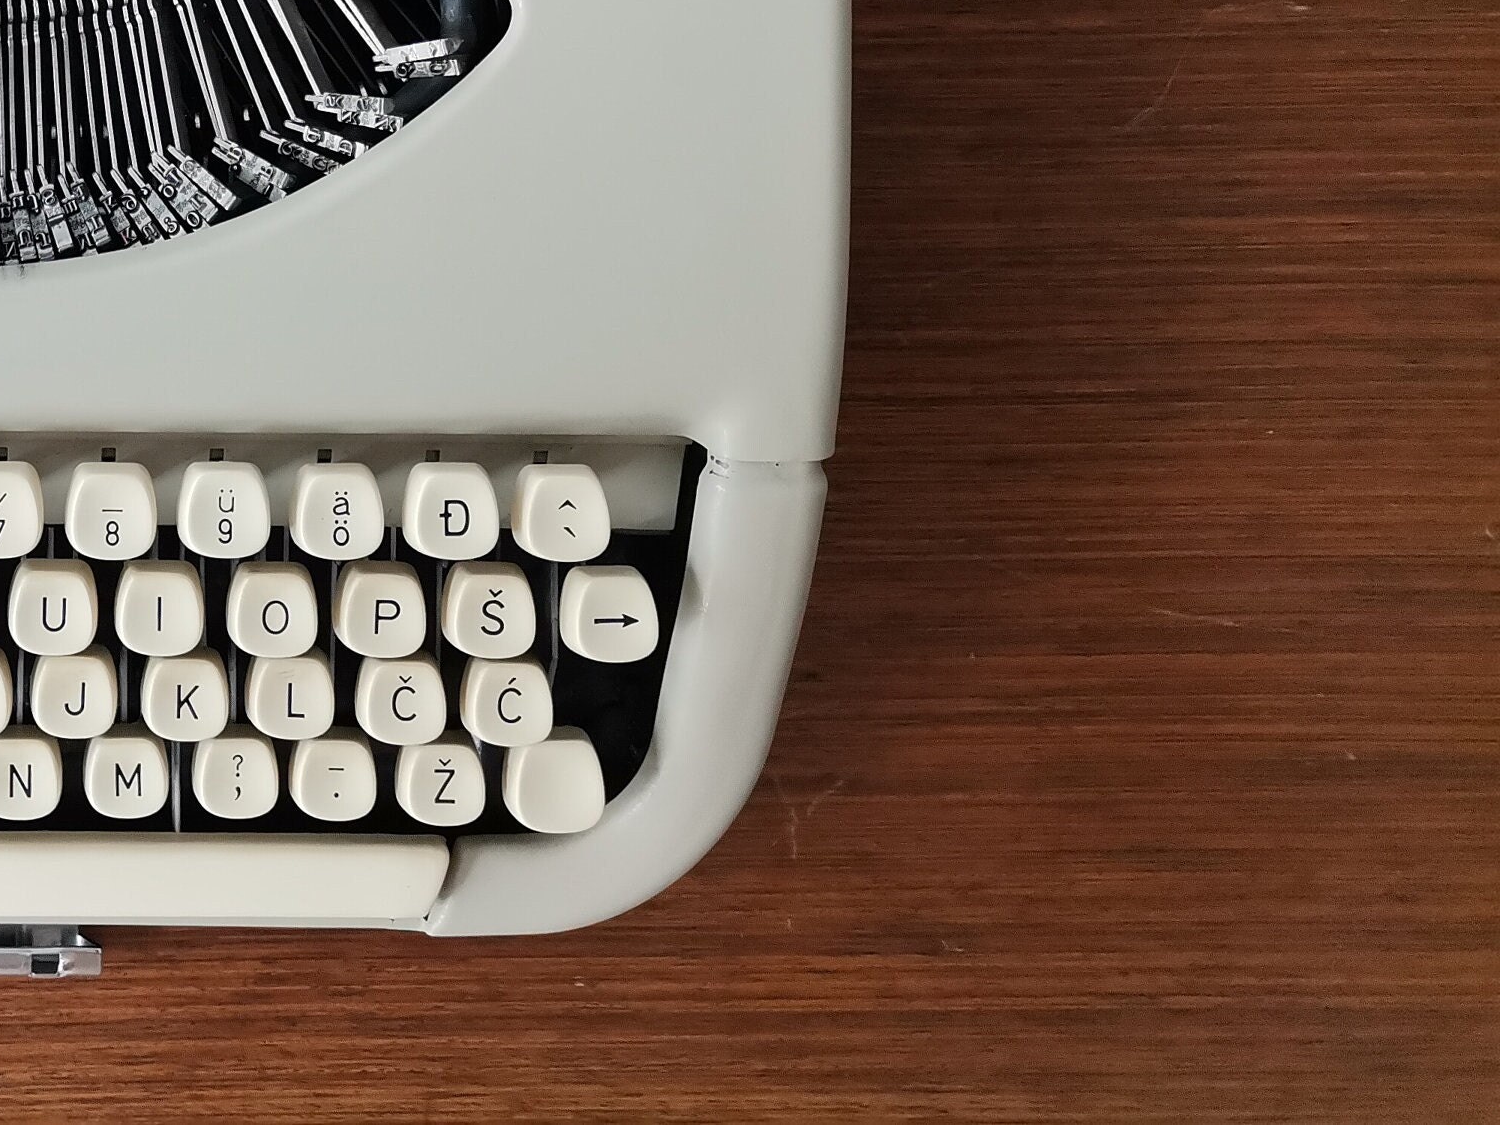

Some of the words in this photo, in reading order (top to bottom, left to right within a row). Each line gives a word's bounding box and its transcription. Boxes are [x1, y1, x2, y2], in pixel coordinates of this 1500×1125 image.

[219, 490, 234, 512] ü
[333, 492, 350, 515] ä
[106, 521, 119, 546] 8
[219, 519, 232, 544] 9
[333, 520, 349, 546] ö
[43, 597, 66, 632] U
[262, 601, 288, 634] O
[375, 600, 400, 634] P
[481, 589, 504, 635] Š
[65, 682, 85, 715] J
[177, 685, 199, 719] K
[288, 683, 304, 718] L
[392, 676, 416, 721] Č
[498, 678, 521, 723] Ć
[10, 764, 31, 797] N
[116, 763, 141, 796] M
[233, 755, 243, 777] ?
[434, 759, 455, 804] Ž
